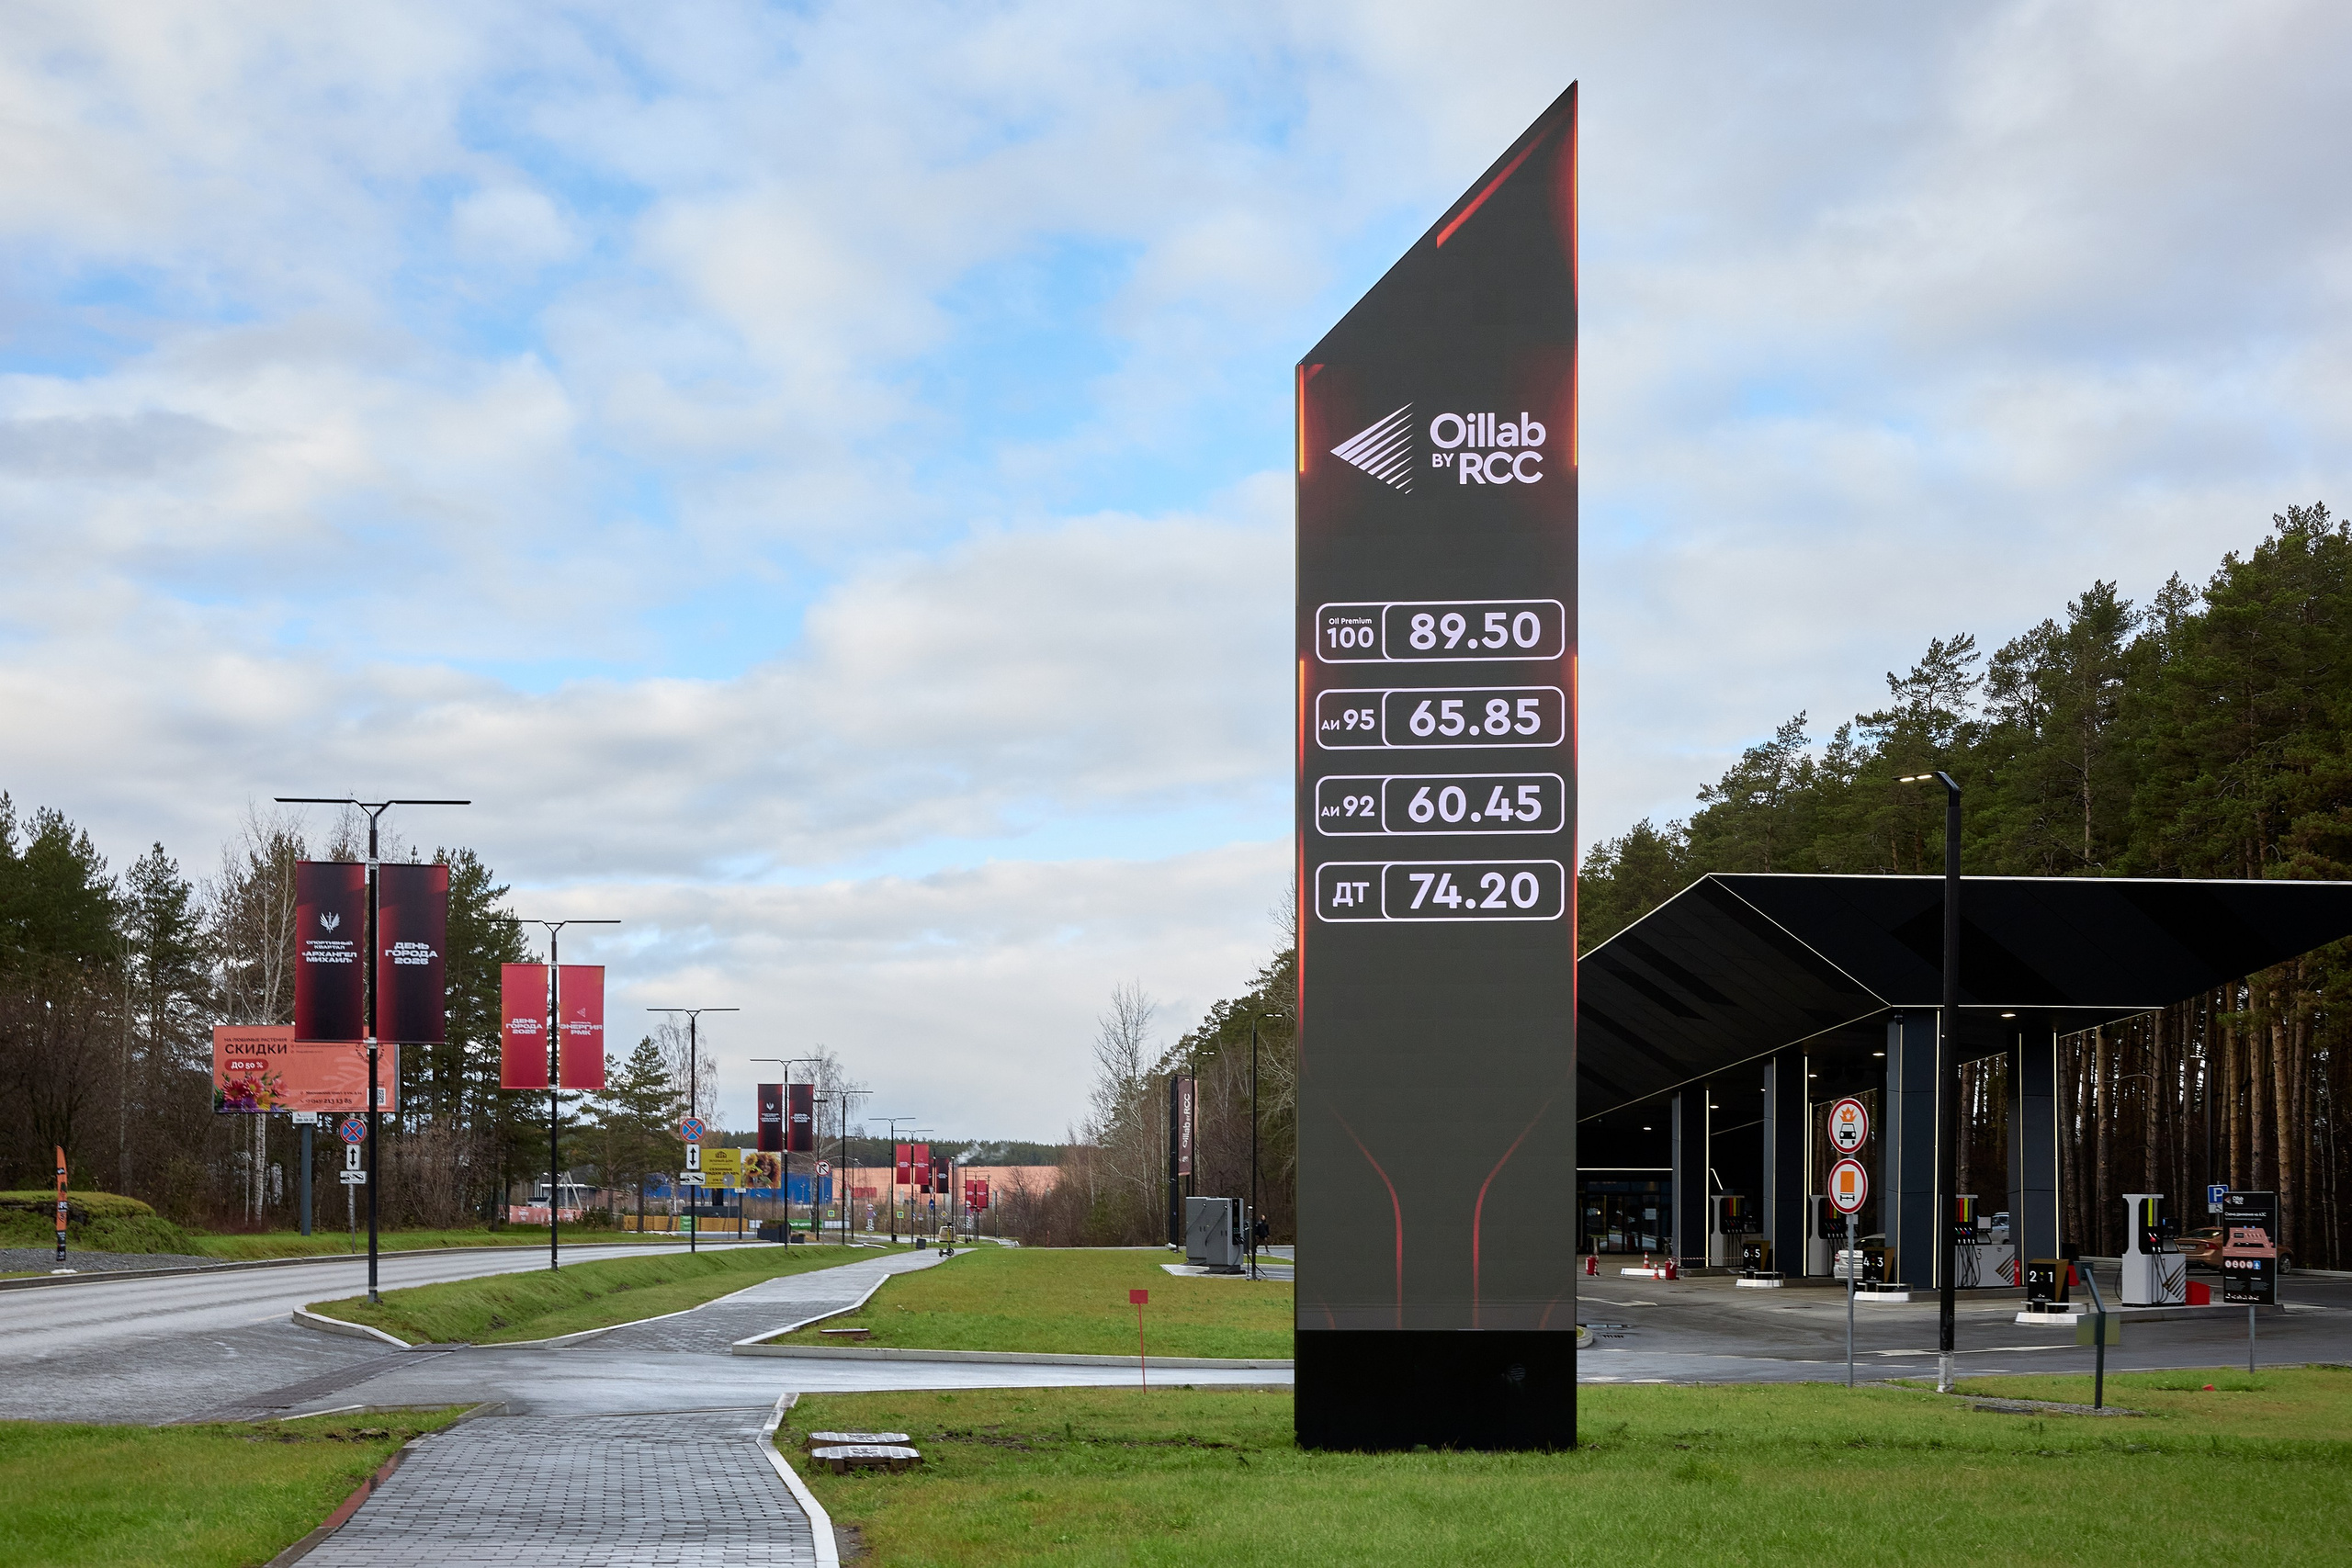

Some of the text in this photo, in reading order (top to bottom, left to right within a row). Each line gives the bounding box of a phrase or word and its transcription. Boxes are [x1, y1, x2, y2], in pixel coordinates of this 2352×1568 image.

[1430, 412, 1547, 449] Oillab
[1431, 450, 1544, 485] BY RCC
[1340, 616, 1373, 625] Premium
[1409, 611, 1542, 650] 89.50
[1327, 626, 1374, 649] 100
[1321, 709, 1375, 731] АИ 95
[1408, 698, 1542, 738] 65.85
[1321, 795, 1375, 818] АИ 92
[1408, 784, 1543, 824] 60.45
[1332, 882, 1370, 908] ДТ
[1408, 872, 1540, 909] 74.20
[385, 950, 438, 958] ГОРОДА
[393, 957, 429, 965] 2025
[224, 1043, 288, 1056] СКИДКИ
[231, 1061, 244, 1070] ДО
[245, 1062, 255, 1070] 50
[1182, 1122, 1191, 1148] Oillab
[2213, 1187, 2224, 1202] P
[1743, 1248, 1761, 1258] 6 5
[1862, 1257, 1884, 1267] 4 3
[2029, 1270, 2053, 1283] 2 1
